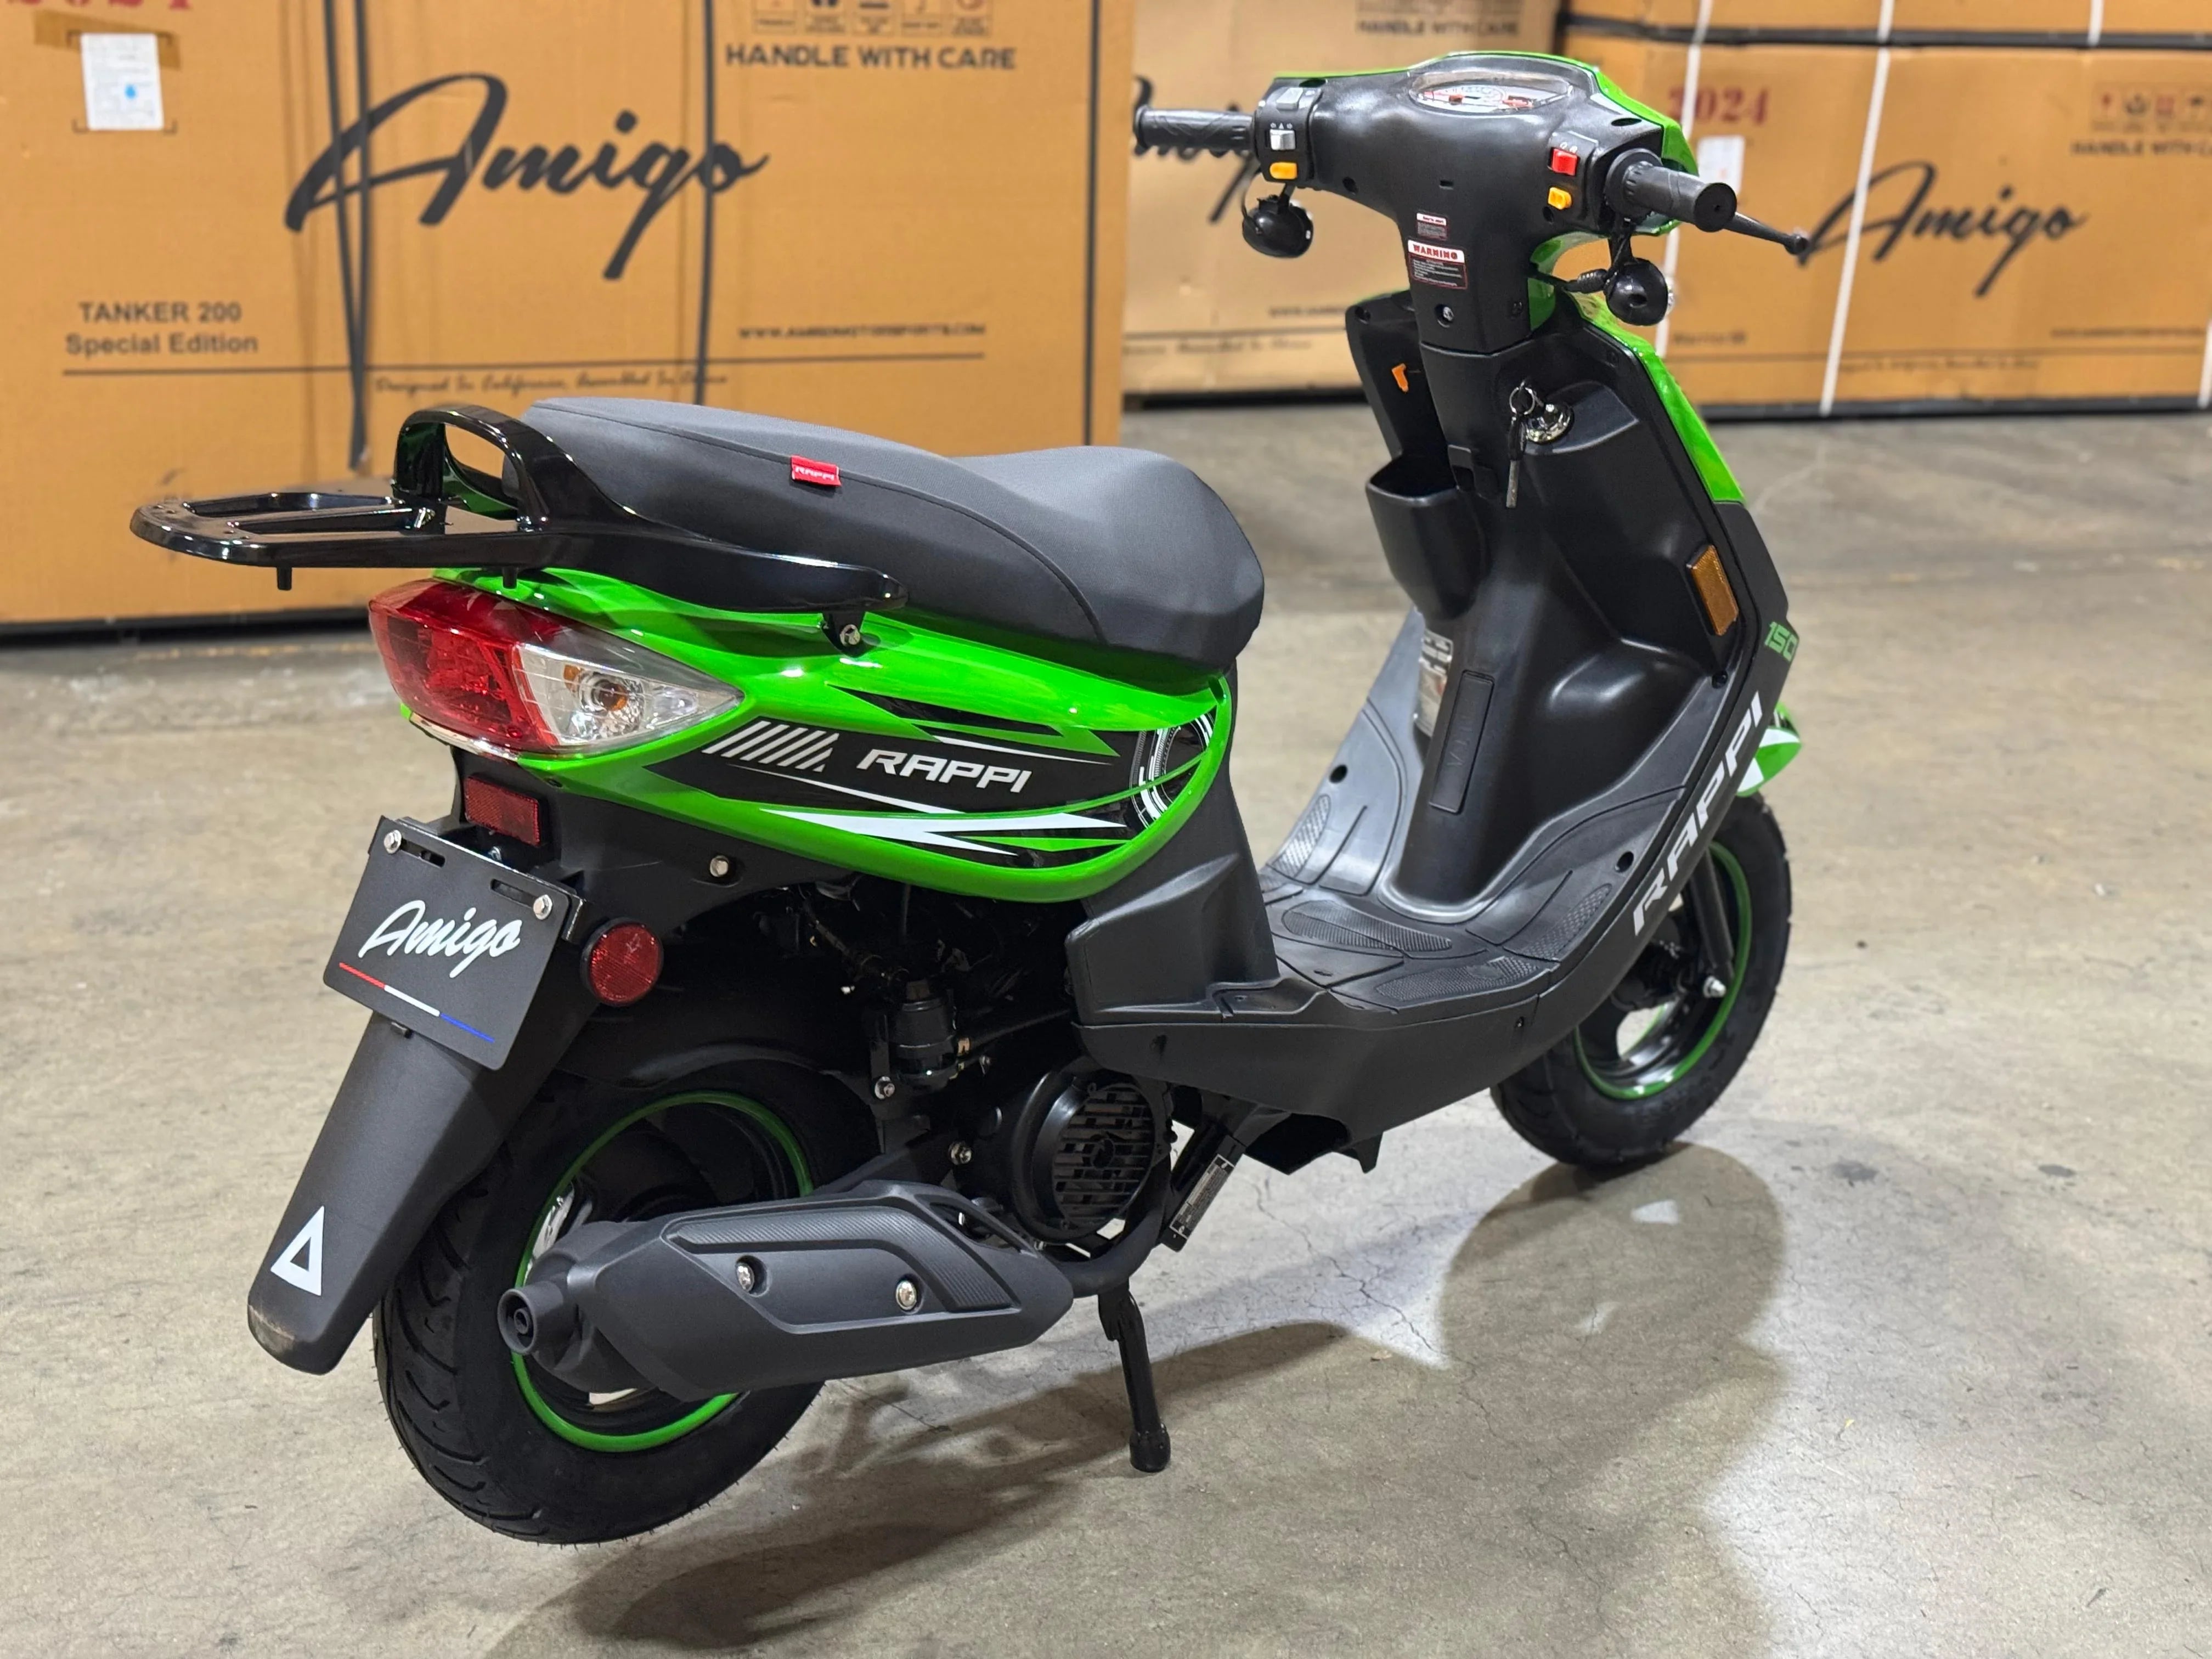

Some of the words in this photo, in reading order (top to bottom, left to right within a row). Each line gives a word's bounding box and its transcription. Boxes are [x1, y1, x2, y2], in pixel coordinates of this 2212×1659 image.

[725, 43, 849, 67] HANDLE
[857, 46, 931, 69] WITH
[938, 46, 1017, 70] CARE
[284, 72, 770, 280] Amigo
[1798, 161, 2089, 298] Amigo
[1413, 244, 1458, 261] WARNING
[79, 301, 190, 324] TANKER
[198, 301, 242, 323] 200
[65, 332, 161, 360] Special
[168, 331, 259, 354] Edition
[1764, 621, 1799, 662] 150
[856, 748, 1032, 793] RAPPI
[1633, 691, 1763, 936] RAPPI
[358, 900, 522, 978] Amigo
